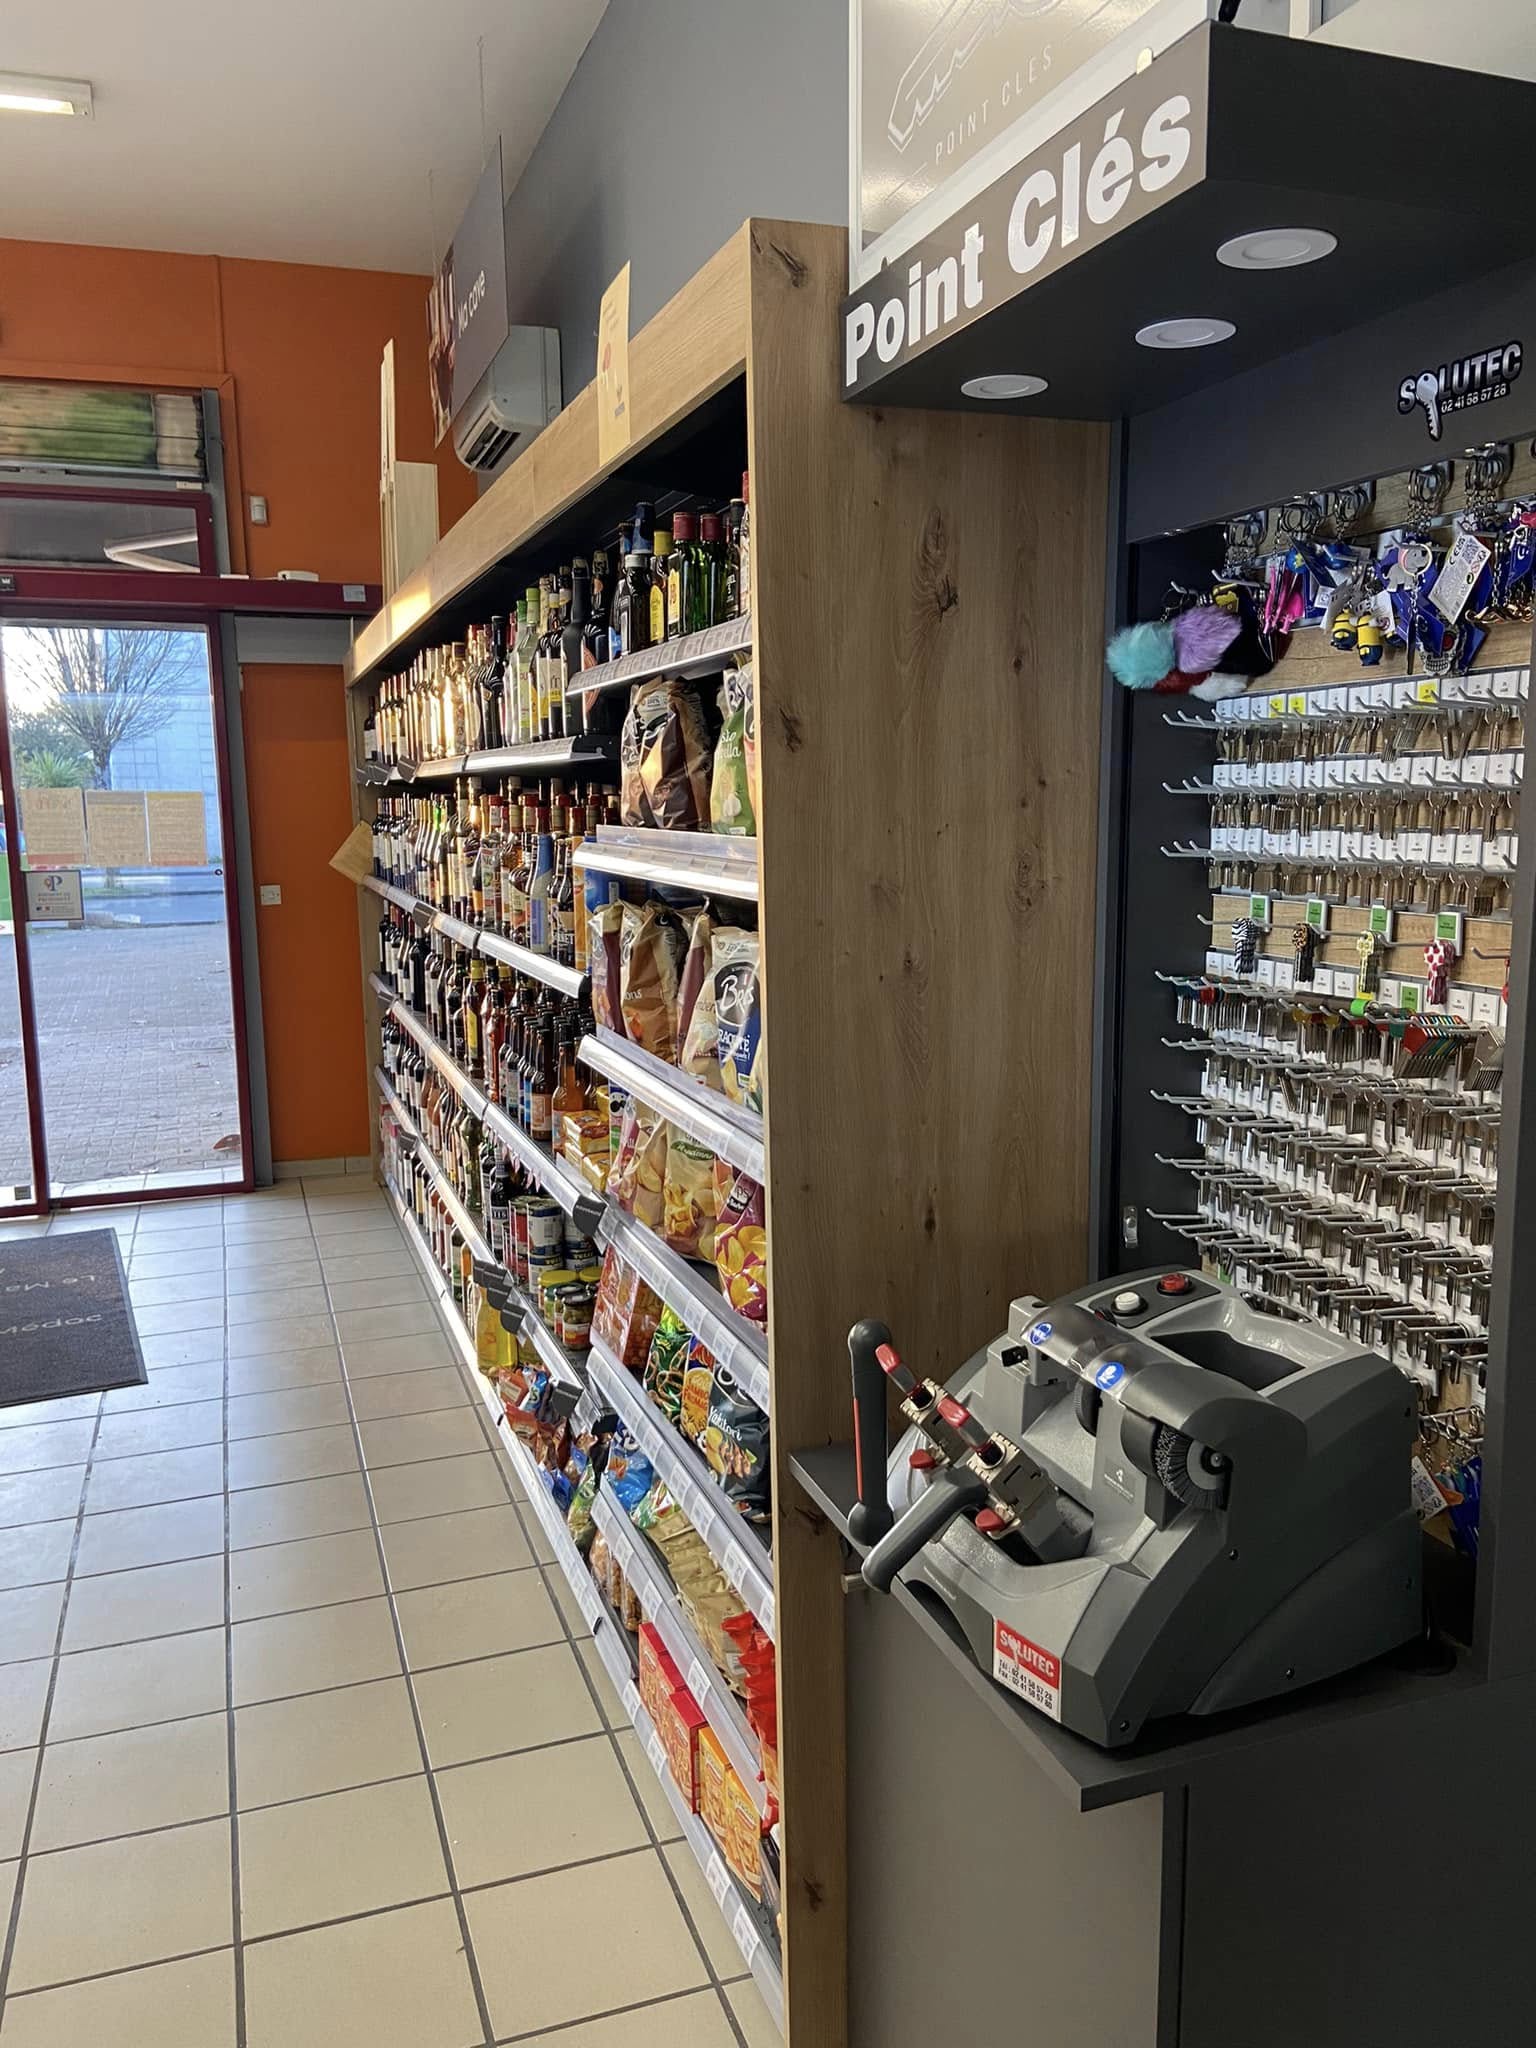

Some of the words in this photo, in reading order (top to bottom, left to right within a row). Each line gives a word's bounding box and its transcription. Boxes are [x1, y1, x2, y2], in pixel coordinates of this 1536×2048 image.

[935, 101, 990, 164] POINT
[845, 222, 984, 387] Point
[1007, 95, 1192, 274] Clés
[468, 270, 486, 318] cave
[1441, 400, 1453, 413] 02
[1455, 396, 1465, 409] 41
[709, 1405, 743, 1441] Yakitori
[1000, 1630, 1055, 1678] SOLUTEC
[1020, 1672, 1027, 1682] 41
